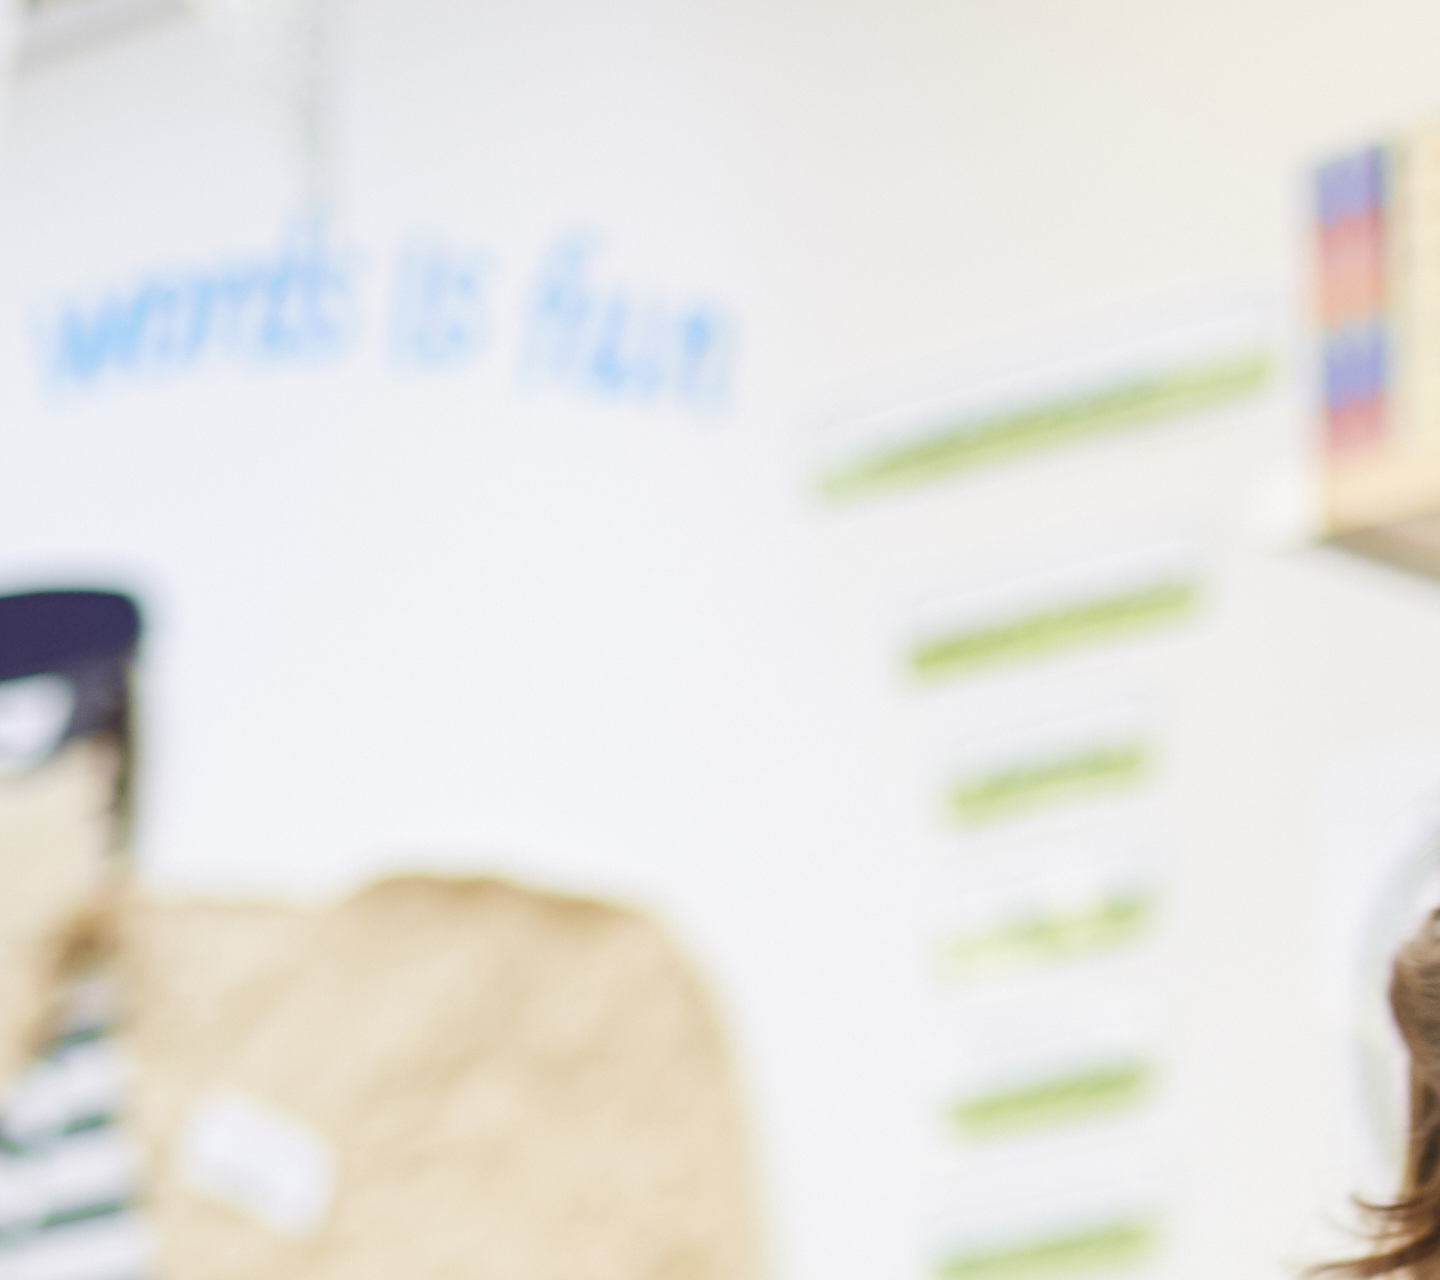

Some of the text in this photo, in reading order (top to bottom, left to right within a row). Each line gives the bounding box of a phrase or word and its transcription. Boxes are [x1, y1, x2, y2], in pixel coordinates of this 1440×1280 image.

[48, 243, 357, 392] words
[402, 250, 486, 362] is
[526, 236, 738, 412] fun
